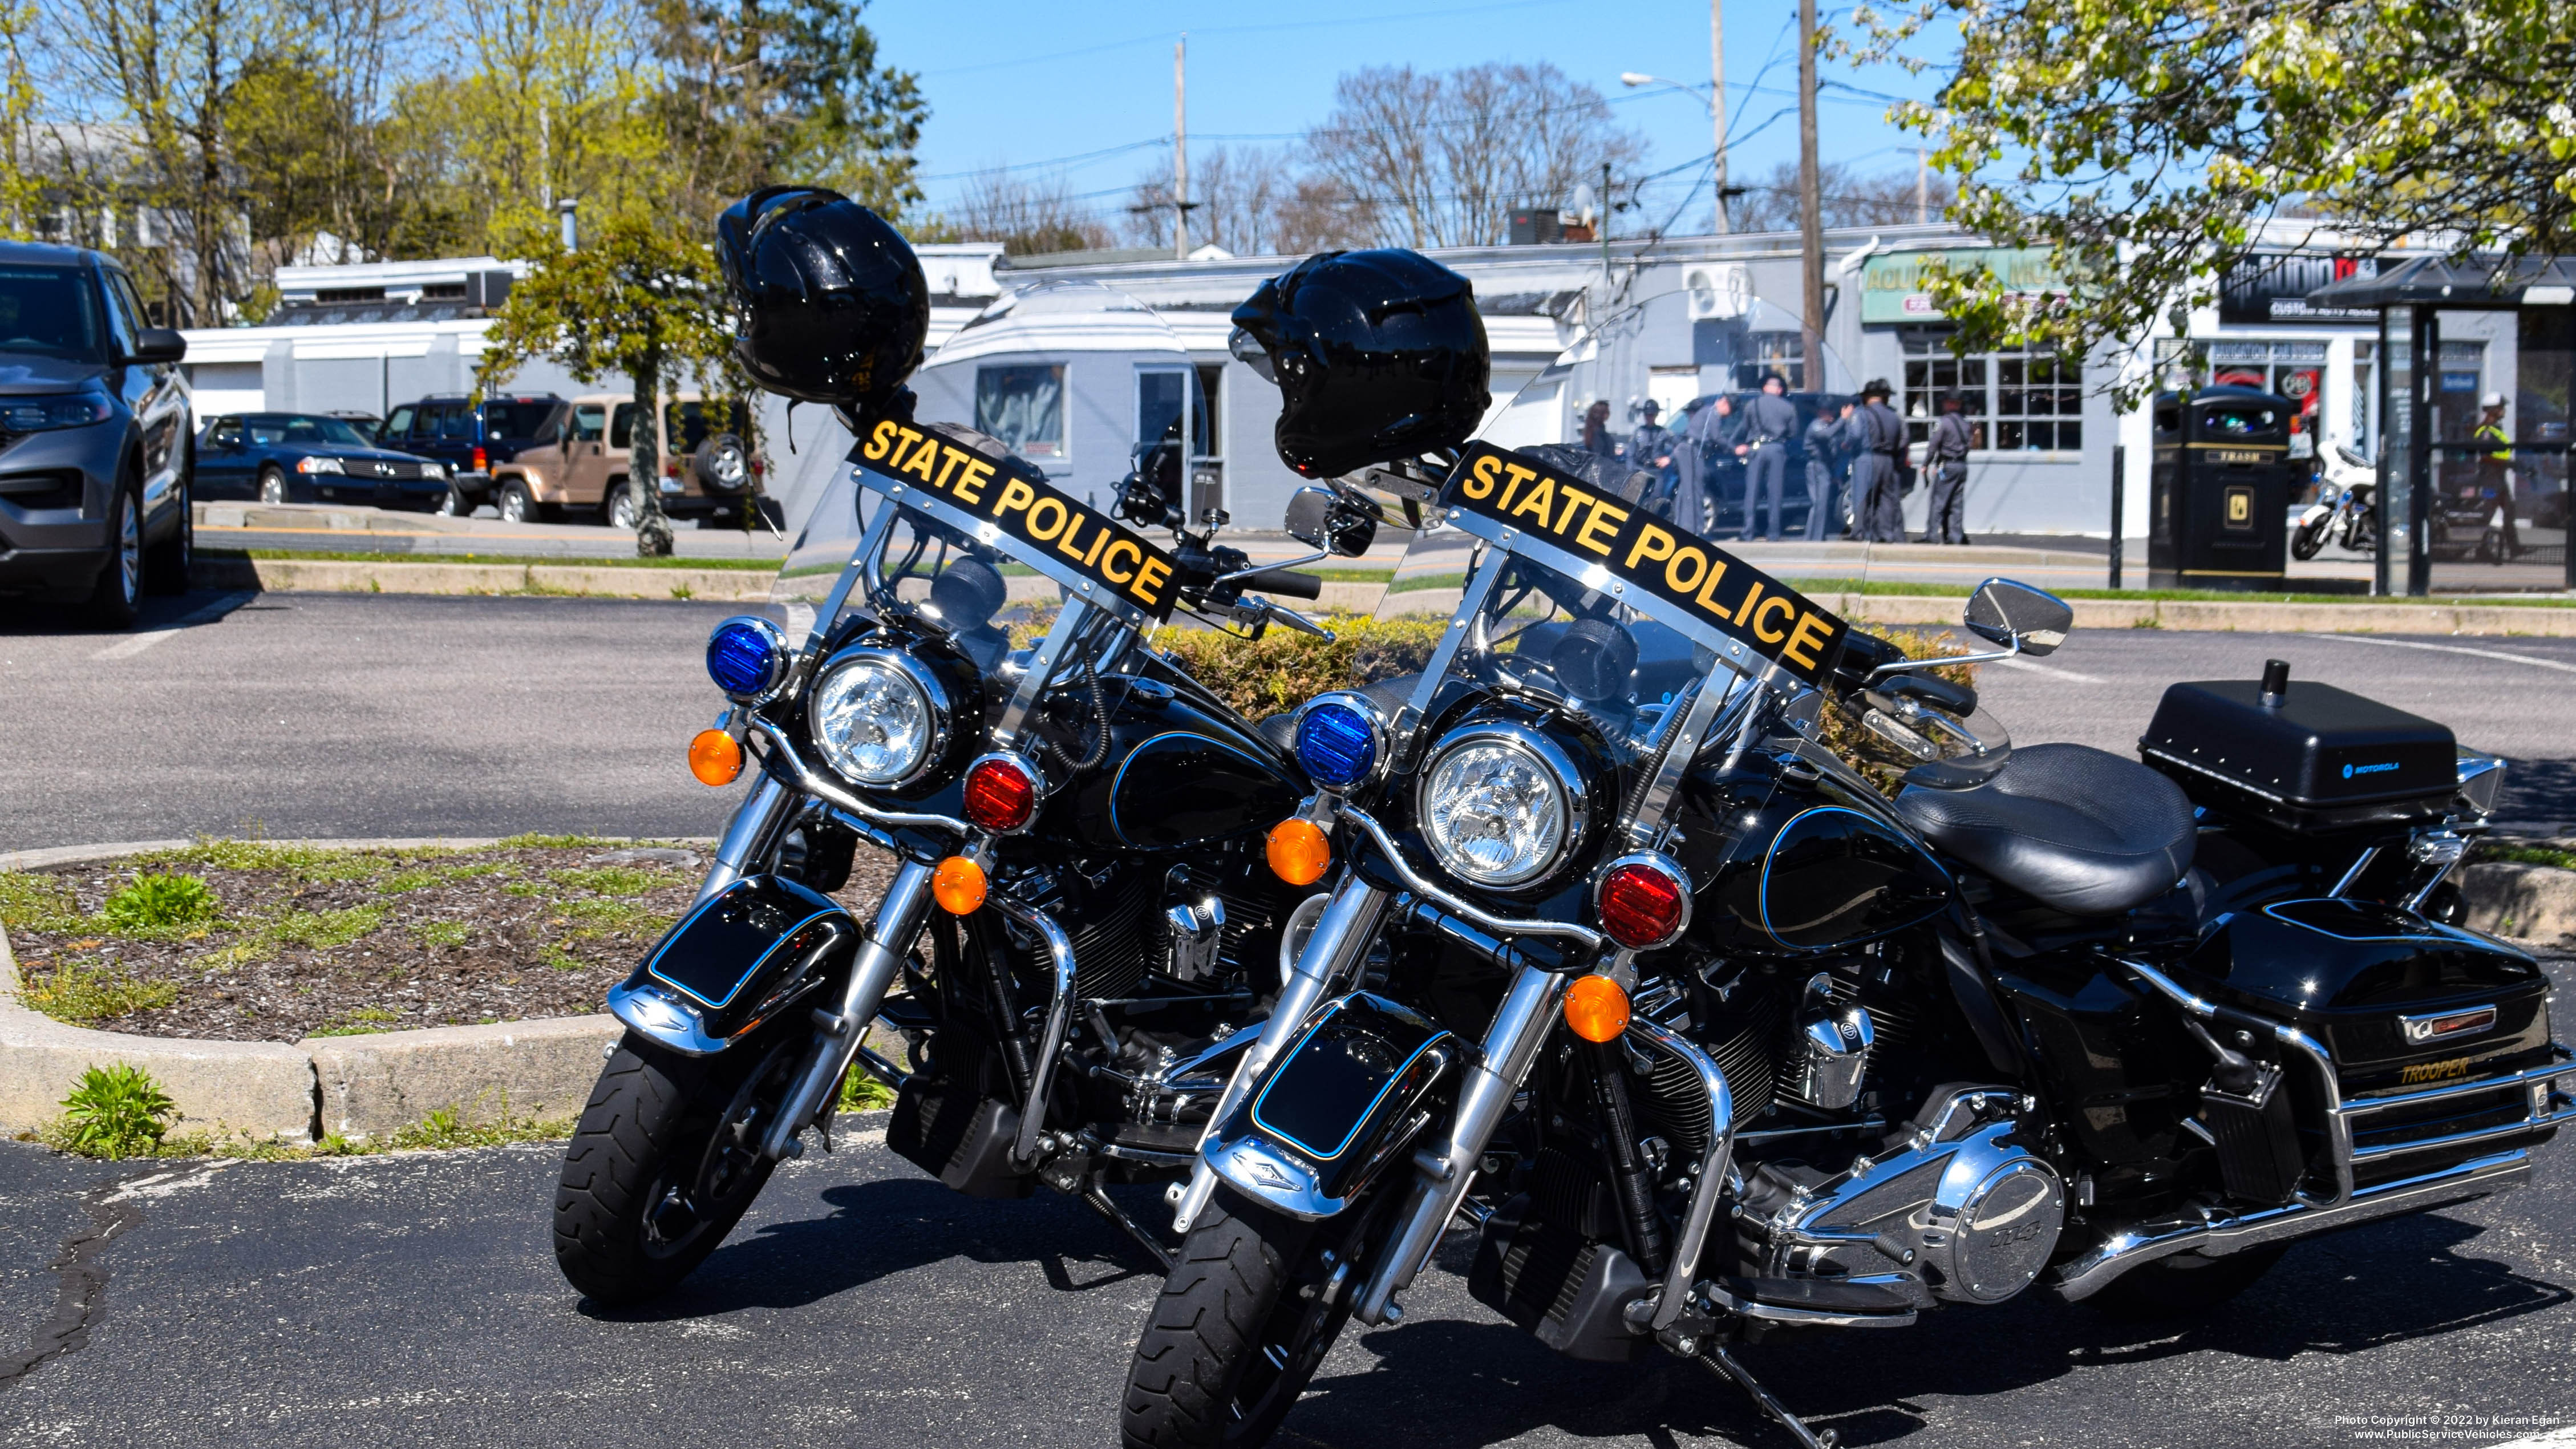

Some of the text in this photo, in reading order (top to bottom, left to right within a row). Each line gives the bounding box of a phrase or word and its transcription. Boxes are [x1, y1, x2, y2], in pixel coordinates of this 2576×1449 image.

[2220, 451, 2260, 462] TRASH
[863, 420, 1173, 605] STATE POLICE
[1463, 455, 1834, 670] STATE POLICE
[2354, 762, 2399, 774] MOTOROLA
[2401, 1057, 2469, 1083] TROOPER
[1989, 1220, 2041, 1248] 114
